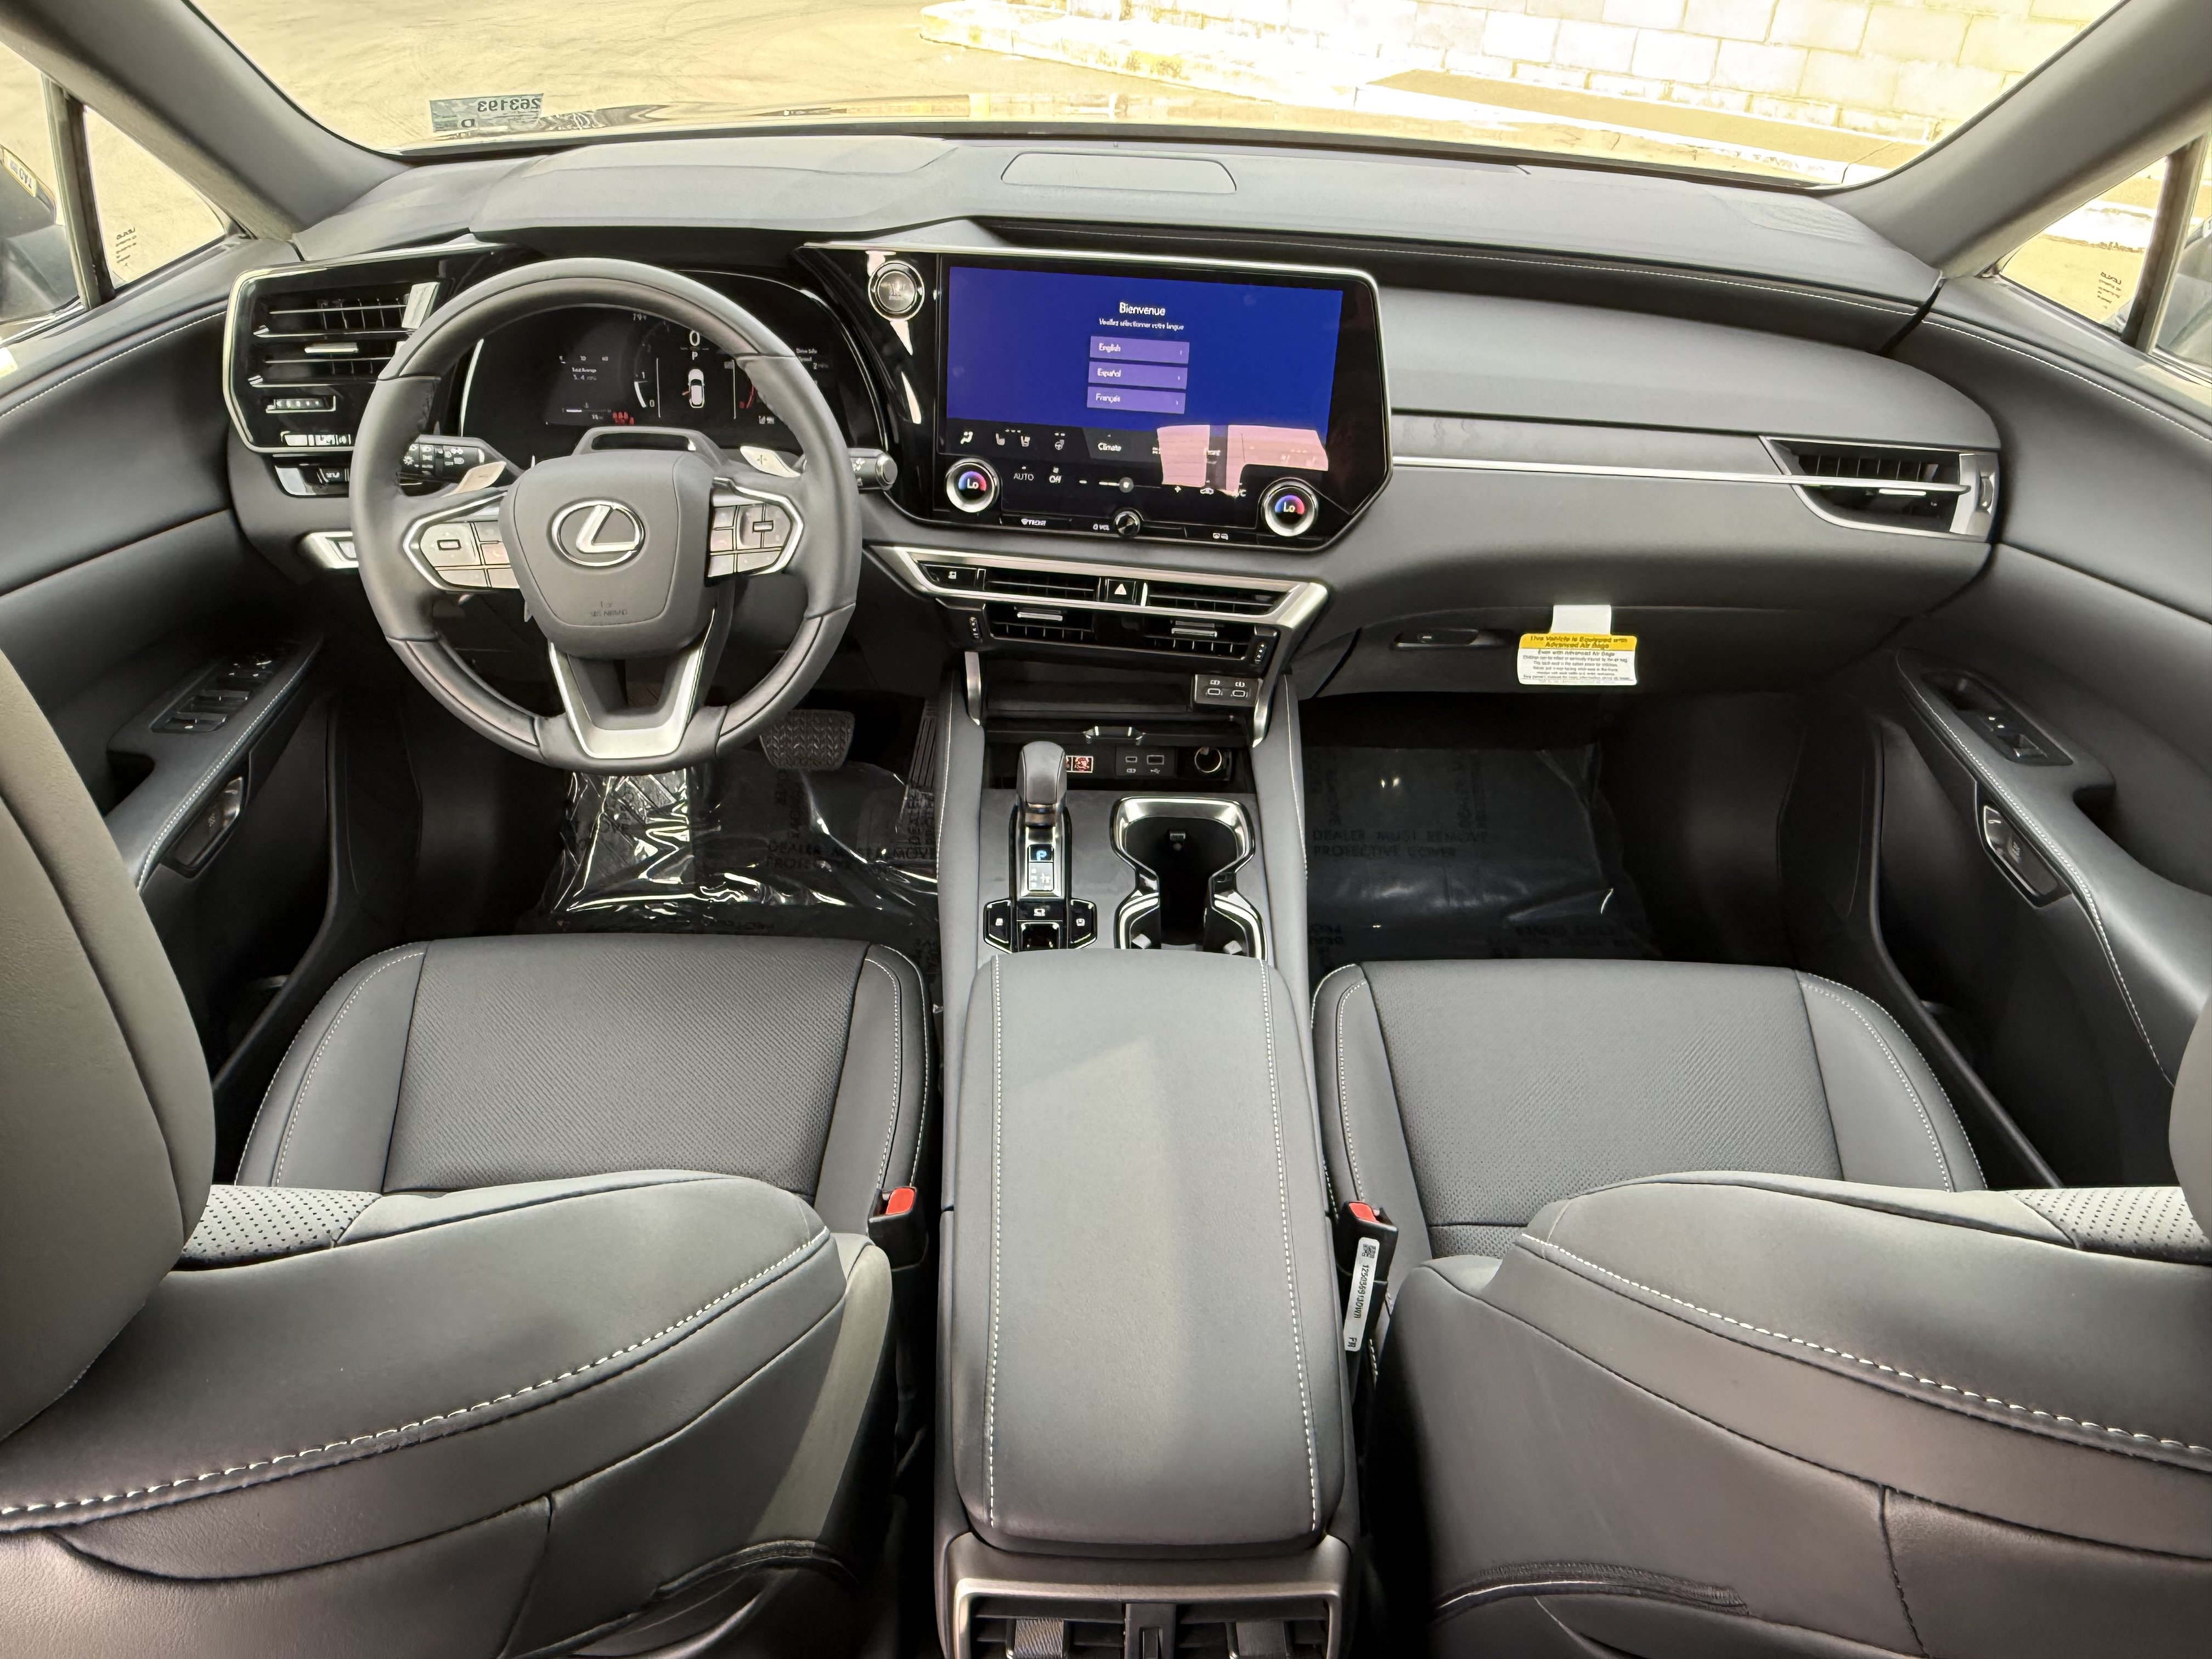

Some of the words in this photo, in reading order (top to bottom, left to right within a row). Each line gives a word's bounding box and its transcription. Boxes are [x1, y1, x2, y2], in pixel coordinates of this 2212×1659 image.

[1119, 302, 1166, 316] Bienvenue
[690, 330, 700, 346] 0
[1099, 343, 1121, 353] English
[692, 352, 698, 360] P
[1098, 442, 1122, 452] Climate
[967, 478, 979, 489] Lo
[1283, 501, 1295, 512] Lo
[1036, 850, 1047, 861] P
